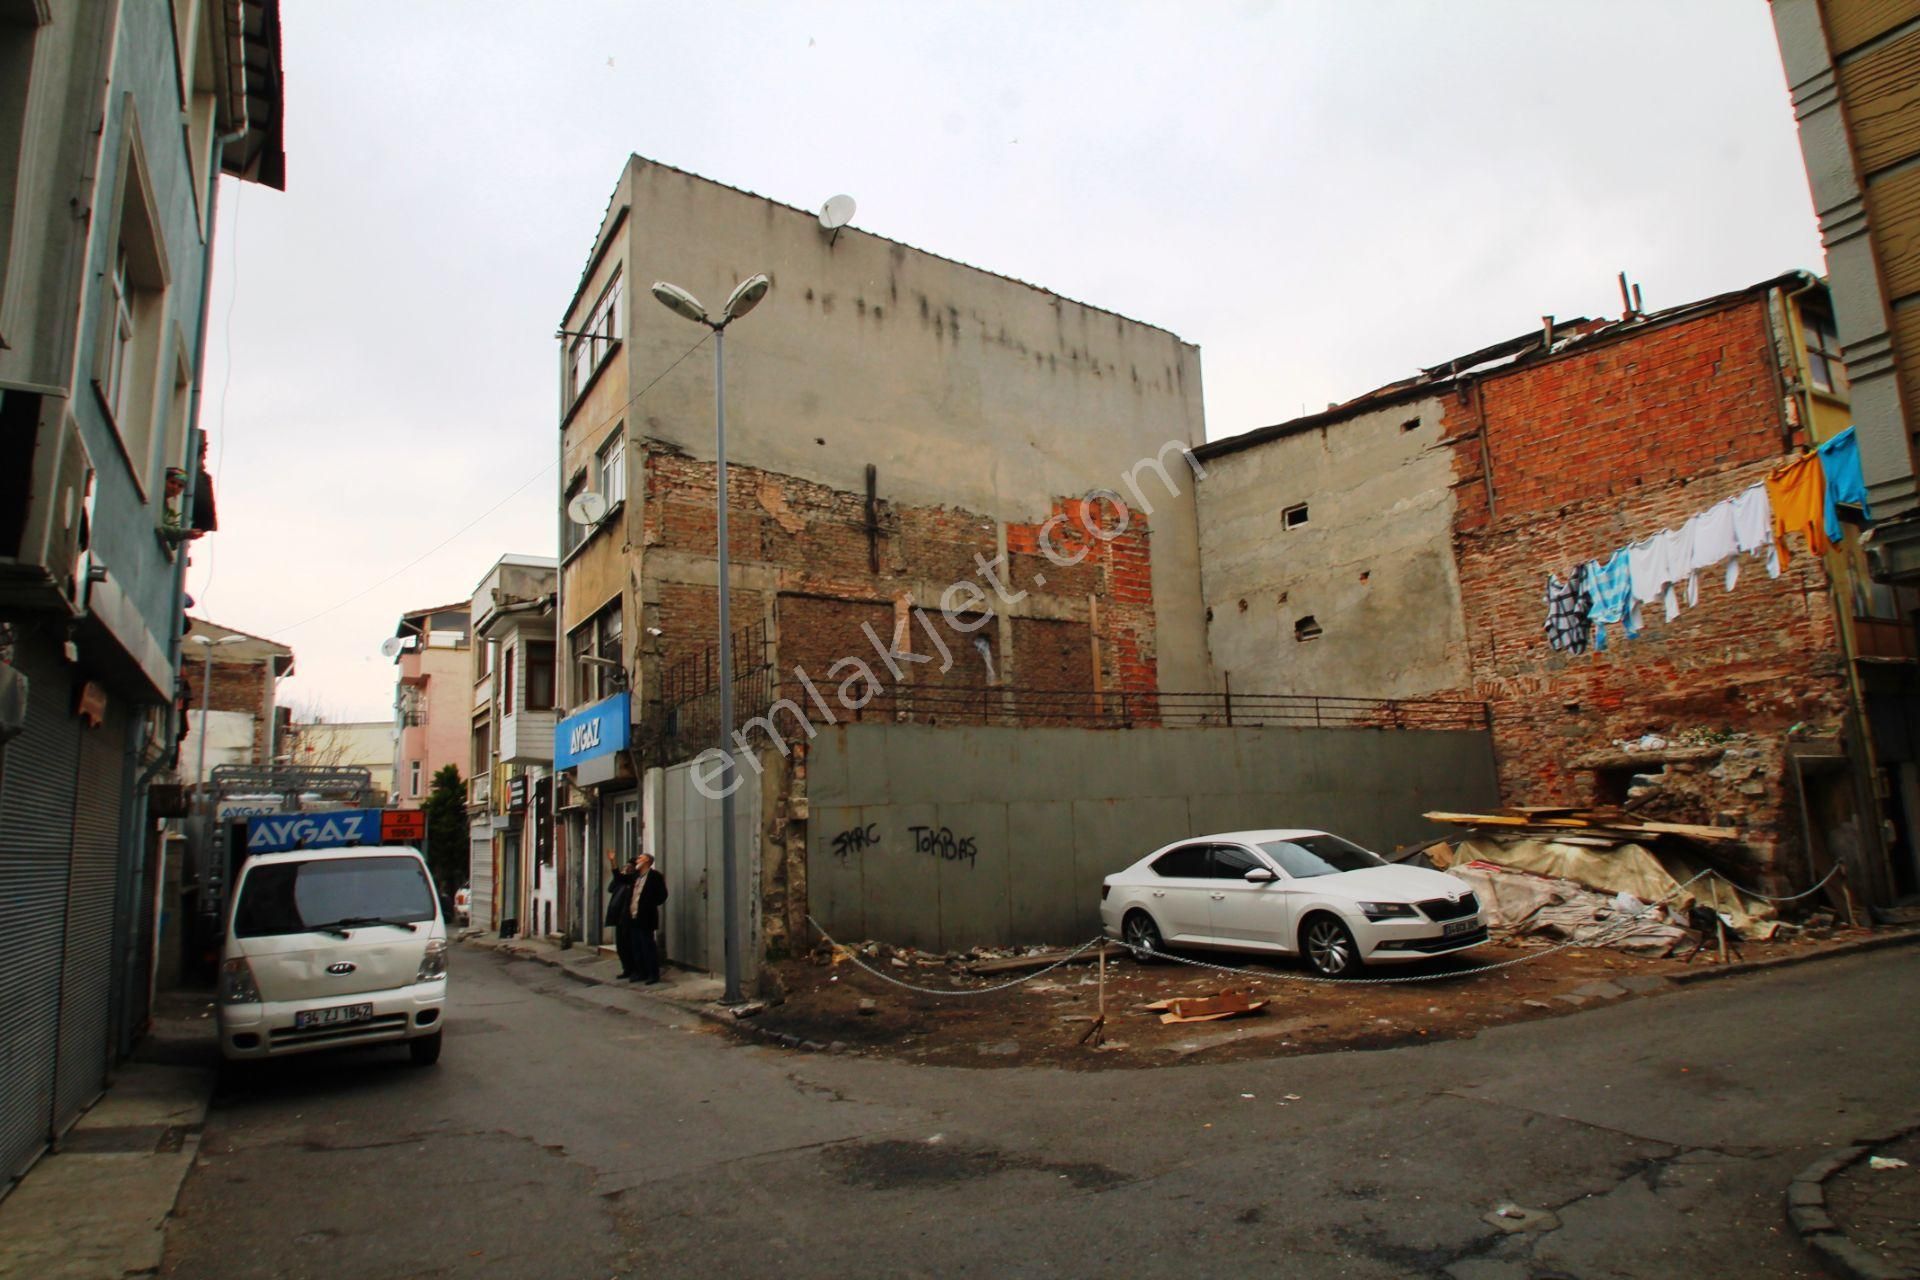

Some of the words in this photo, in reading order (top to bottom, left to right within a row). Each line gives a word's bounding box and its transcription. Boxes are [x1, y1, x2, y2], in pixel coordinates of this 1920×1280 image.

[570, 716, 601, 756] AYGAZ
[220, 806, 275, 818] AYGAZ
[248, 815, 364, 847] AYGAZ
[305, 1012, 319, 1025] 34
